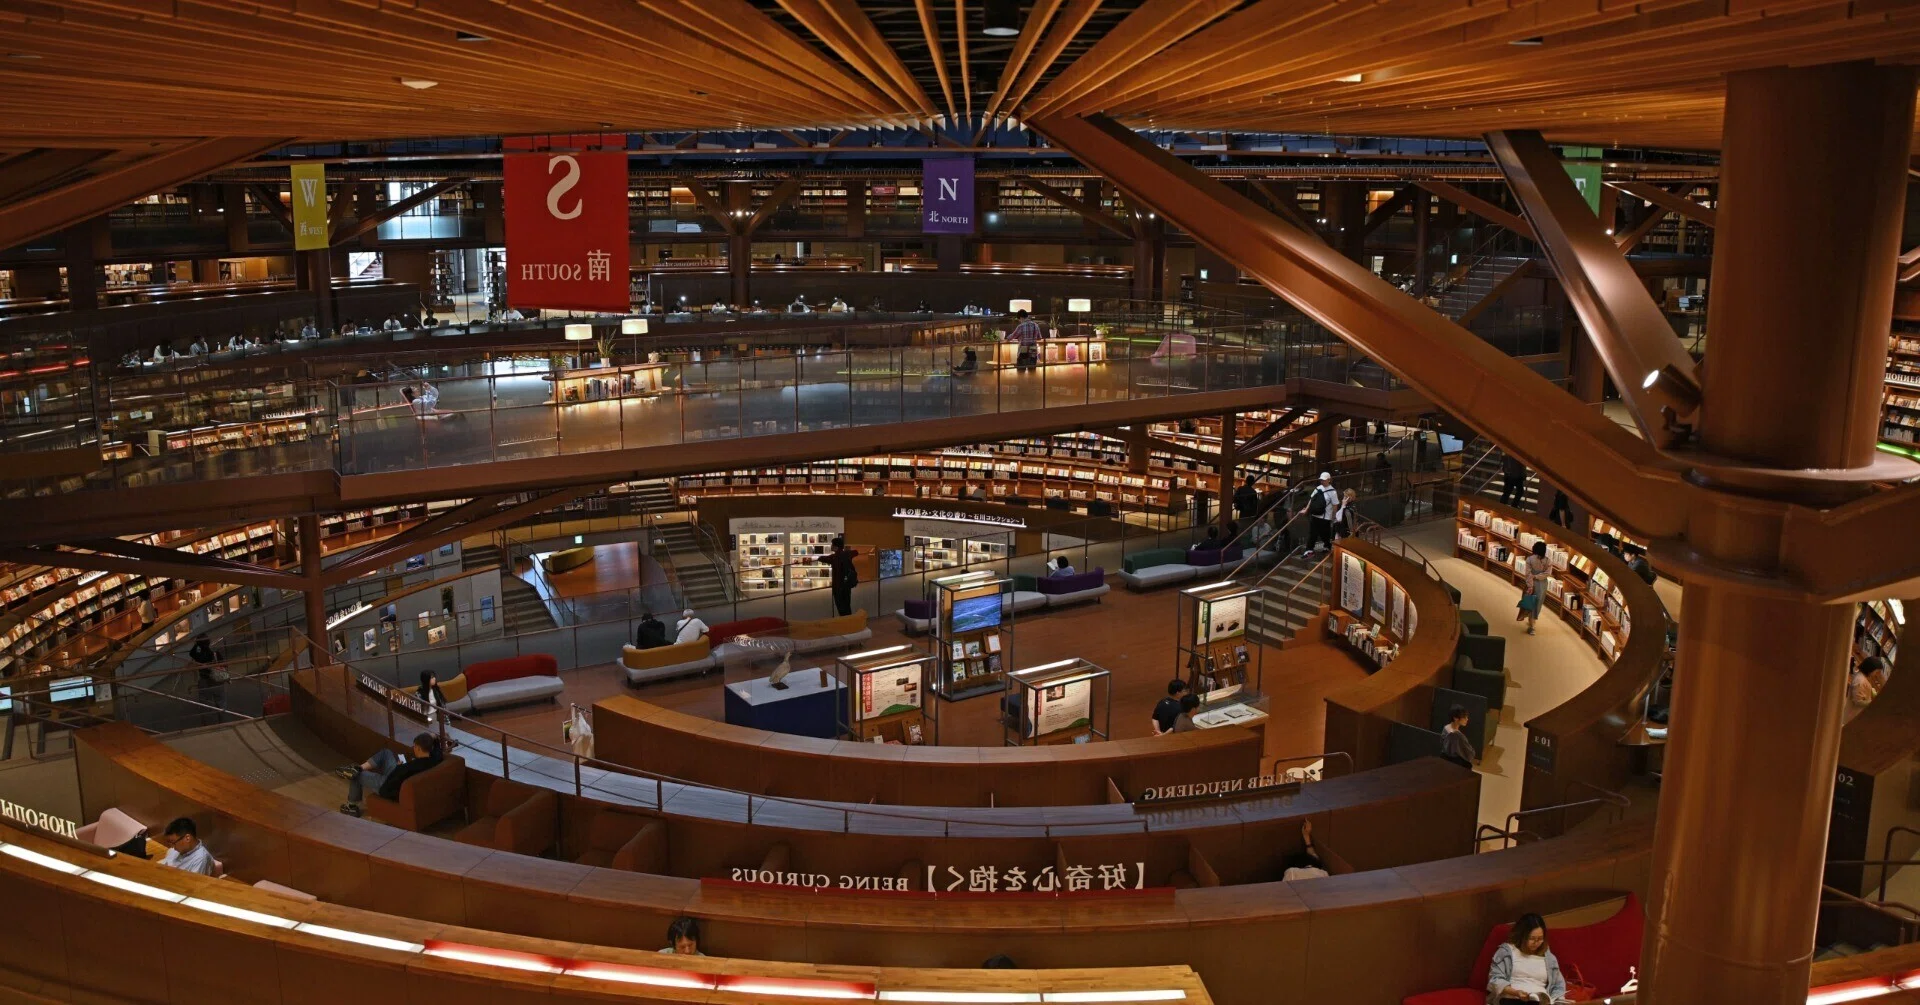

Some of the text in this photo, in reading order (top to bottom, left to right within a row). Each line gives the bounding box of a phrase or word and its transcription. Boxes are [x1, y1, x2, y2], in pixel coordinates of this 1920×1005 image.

[299, 179, 318, 207] W
[938, 178, 959, 201] N
[928, 210, 968, 224] 北 NORTH
[309, 227, 323, 235] WEST
[1838, 773, 1854, 786] 02
